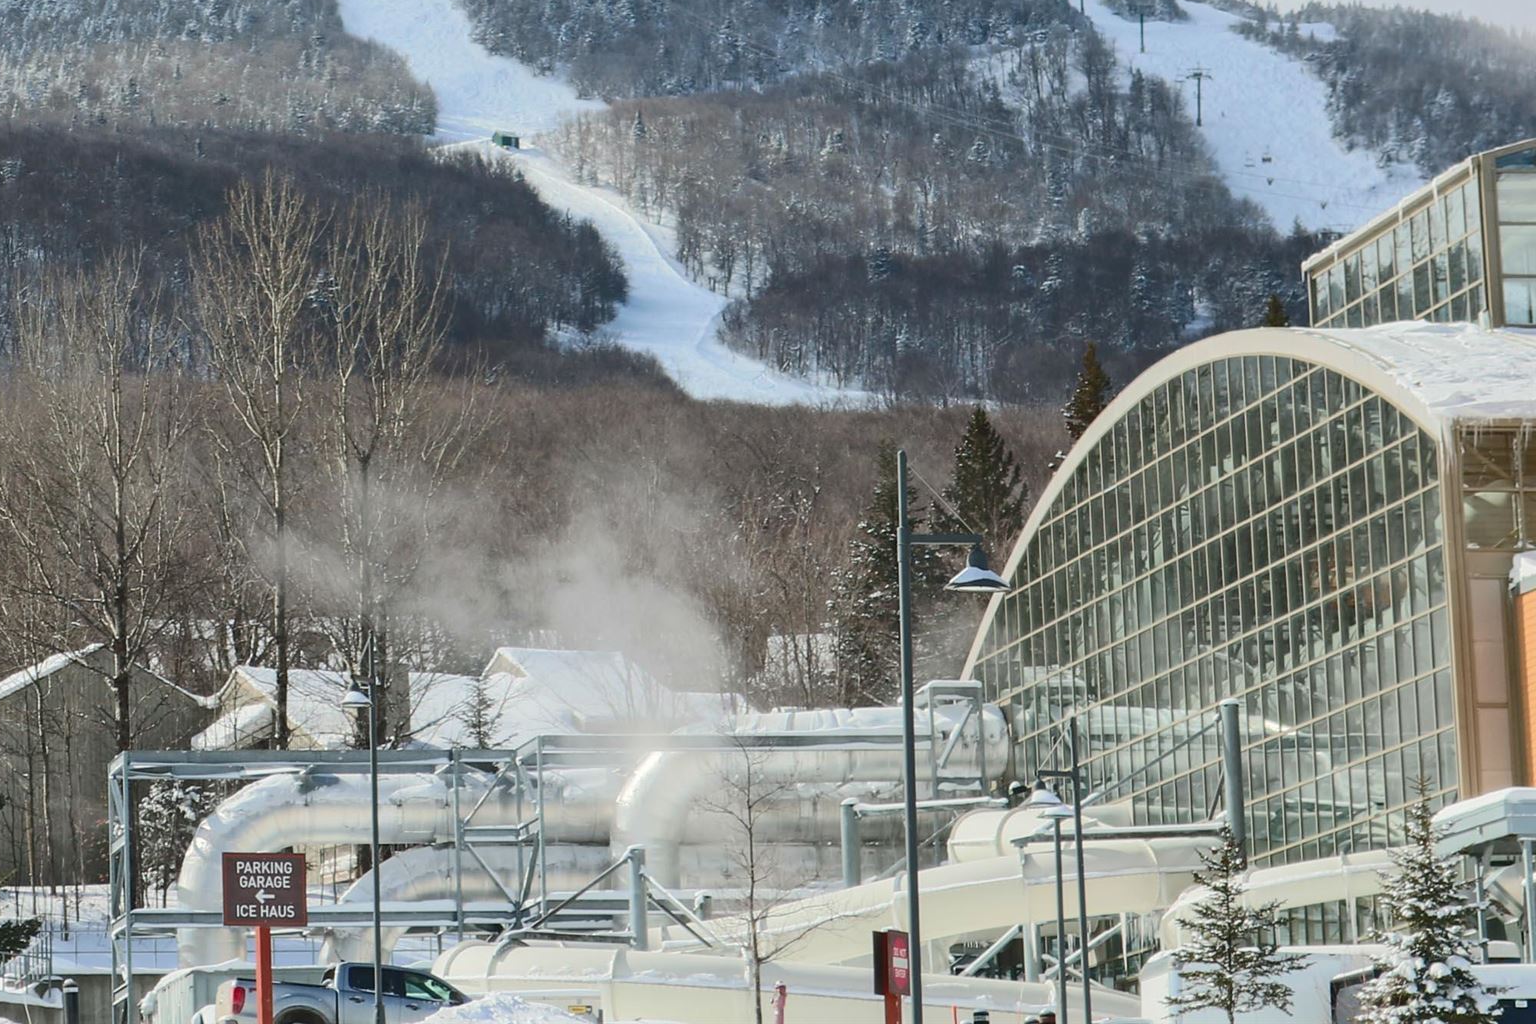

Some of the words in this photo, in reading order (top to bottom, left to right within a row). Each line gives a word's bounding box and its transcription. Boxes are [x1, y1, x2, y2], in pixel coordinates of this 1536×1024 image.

[236, 861, 293, 874] PARKING
[239, 875, 291, 888] GARAGE
[236, 904, 257, 917] ICE
[260, 905, 295, 918] HAUS
